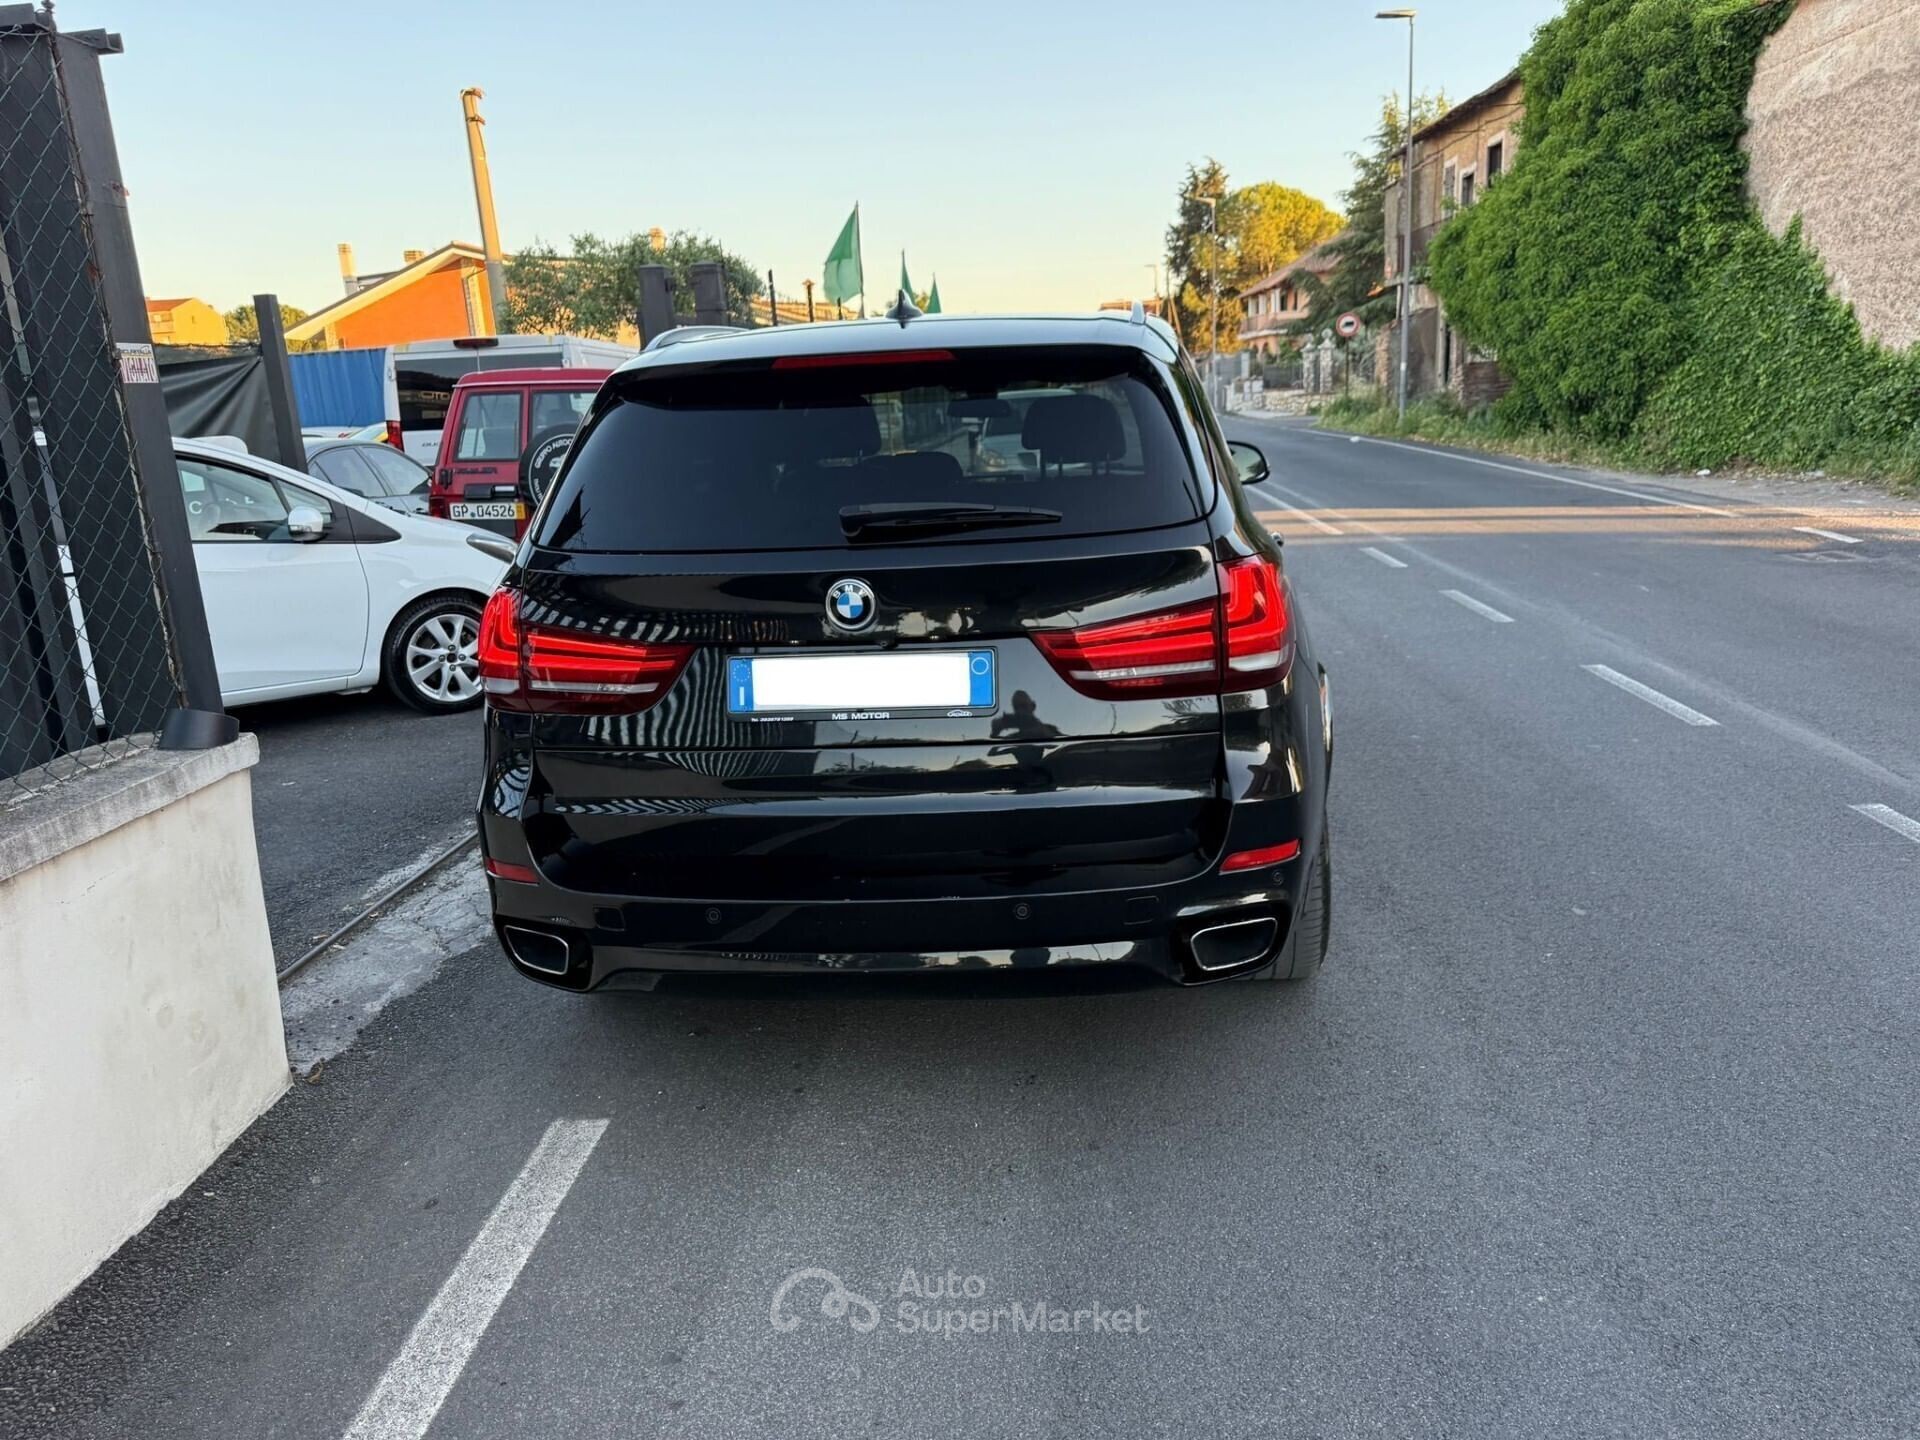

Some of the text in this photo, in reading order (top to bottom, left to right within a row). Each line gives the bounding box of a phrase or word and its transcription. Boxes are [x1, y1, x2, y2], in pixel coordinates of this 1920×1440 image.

[477, 505, 515, 517] 04526
[832, 584, 869, 599] BMW
[832, 711, 890, 720] MS MOTOR
